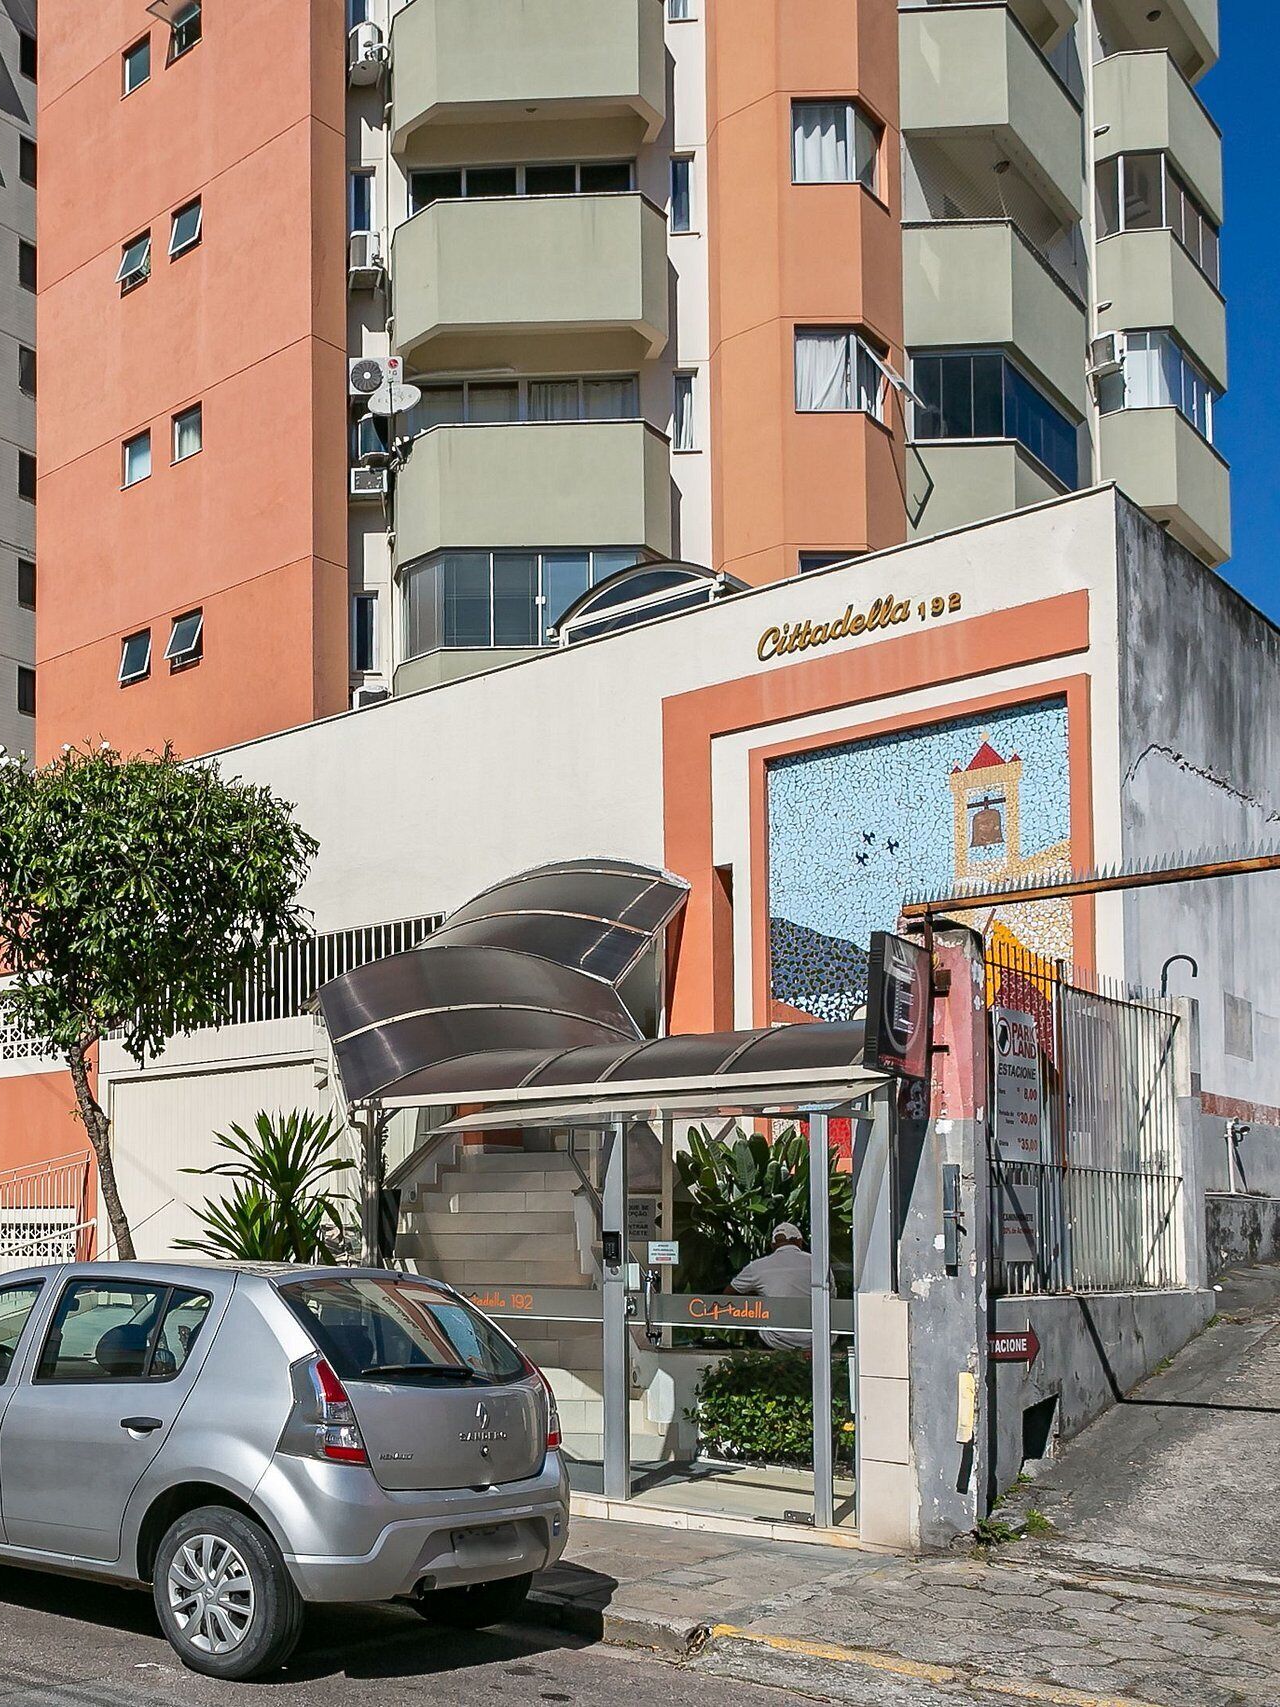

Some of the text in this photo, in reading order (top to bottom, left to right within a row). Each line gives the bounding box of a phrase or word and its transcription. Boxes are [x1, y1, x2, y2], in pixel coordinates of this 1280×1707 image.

[756, 592, 962, 662] Cittadella 192
[1011, 1022, 1037, 1043] PARK
[1012, 1038, 1037, 1060] LAND
[998, 1063, 1037, 1080] ESTACIONE
[510, 1293, 533, 1310] 192
[688, 1297, 770, 1320] Cittadella
